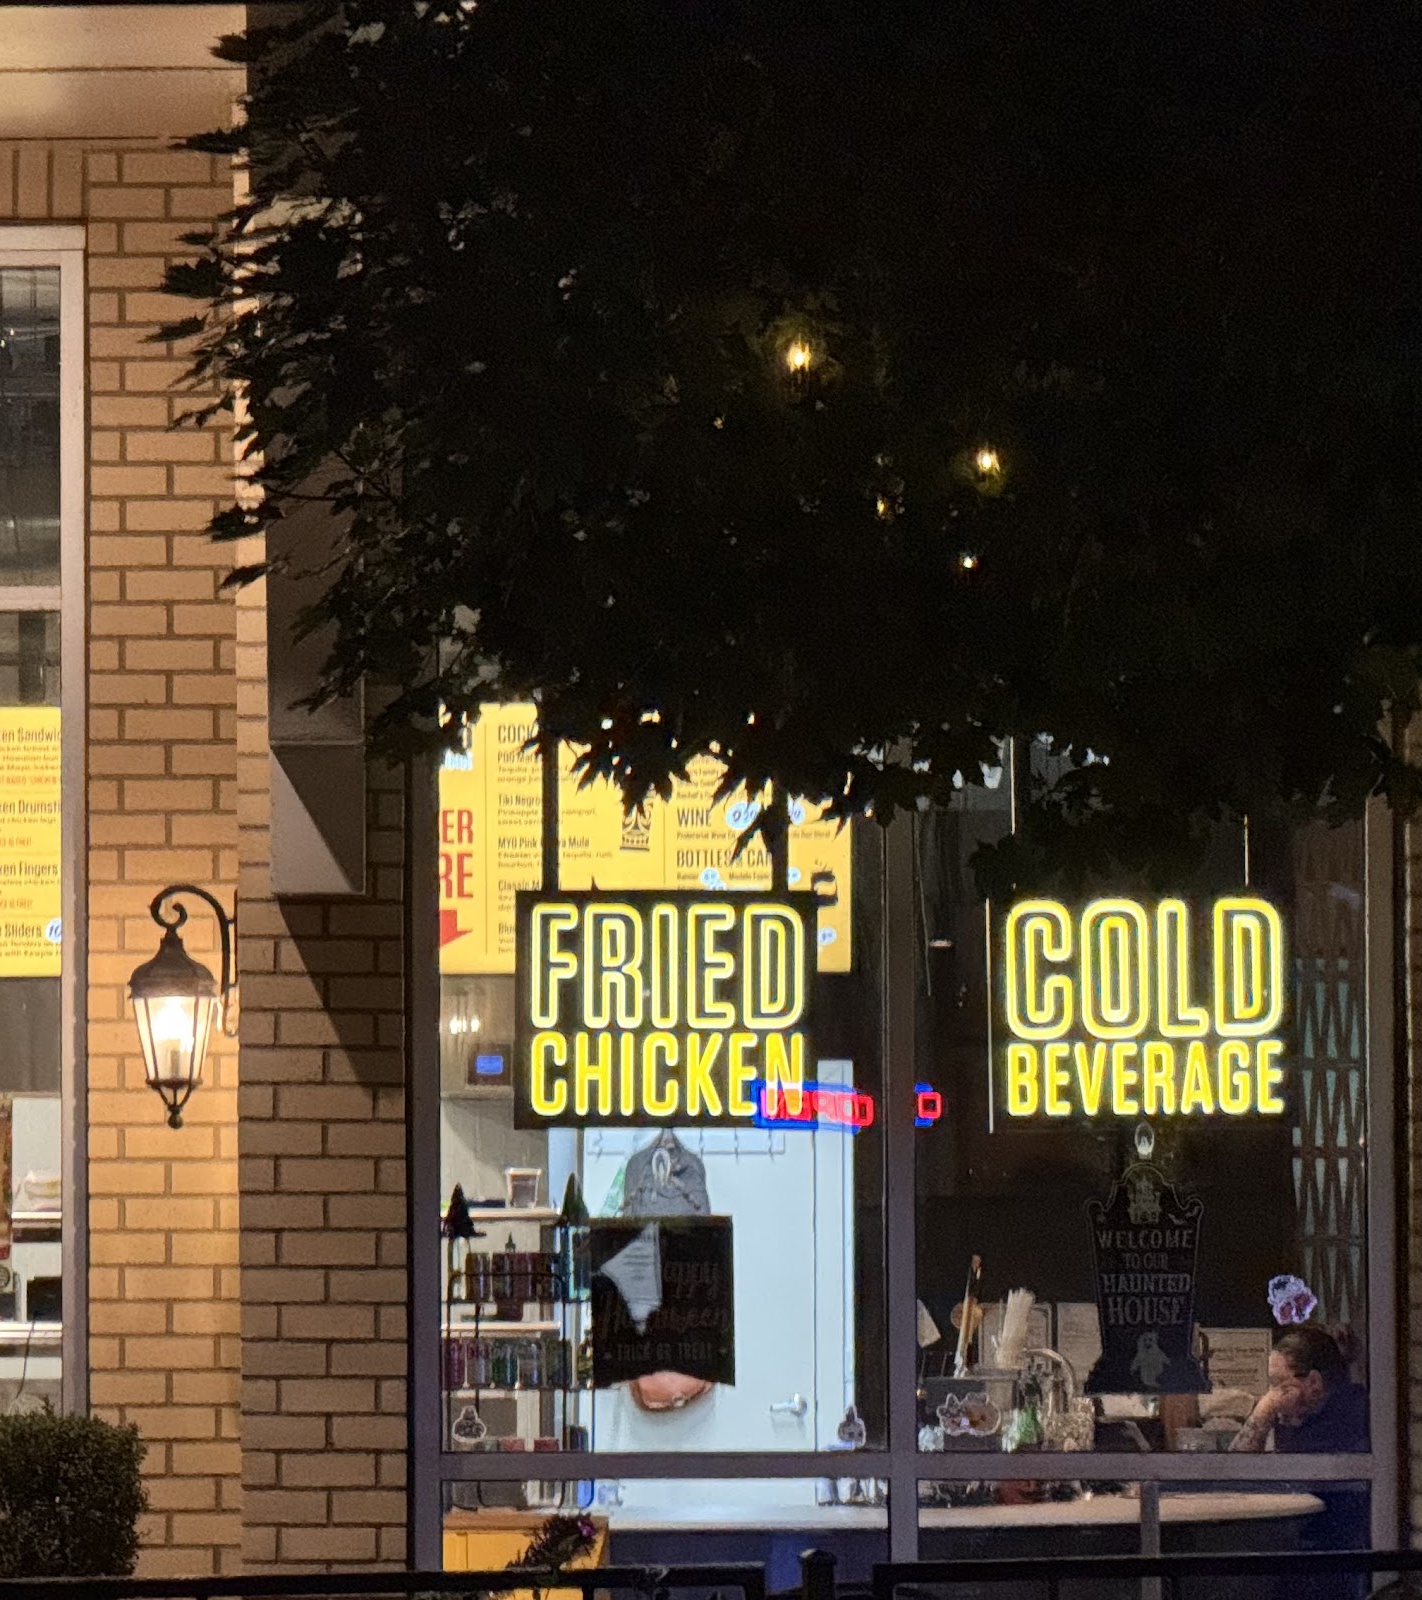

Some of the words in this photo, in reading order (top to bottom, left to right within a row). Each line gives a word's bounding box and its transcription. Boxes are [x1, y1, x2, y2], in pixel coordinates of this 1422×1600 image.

[498, 795, 513, 807] Tiki
[519, 837, 537, 848] Pink
[568, 837, 589, 848] Mule
[19, 861, 58, 876] Fingers
[5, 923, 42, 938] Sliders
[531, 903, 805, 1029] FRIED
[1006, 898, 1283, 1039] COLD
[531, 1031, 804, 1117] CHICKEN
[1007, 1040, 1284, 1116] BEVERAGE
[1096, 1229, 1194, 1249] WELCOME
[1124, 1252, 1141, 1270] TO
[1144, 1252, 1169, 1270] OUR
[1101, 1273, 1192, 1293] HAUNTED
[1107, 1296, 1186, 1325] HOUSE
